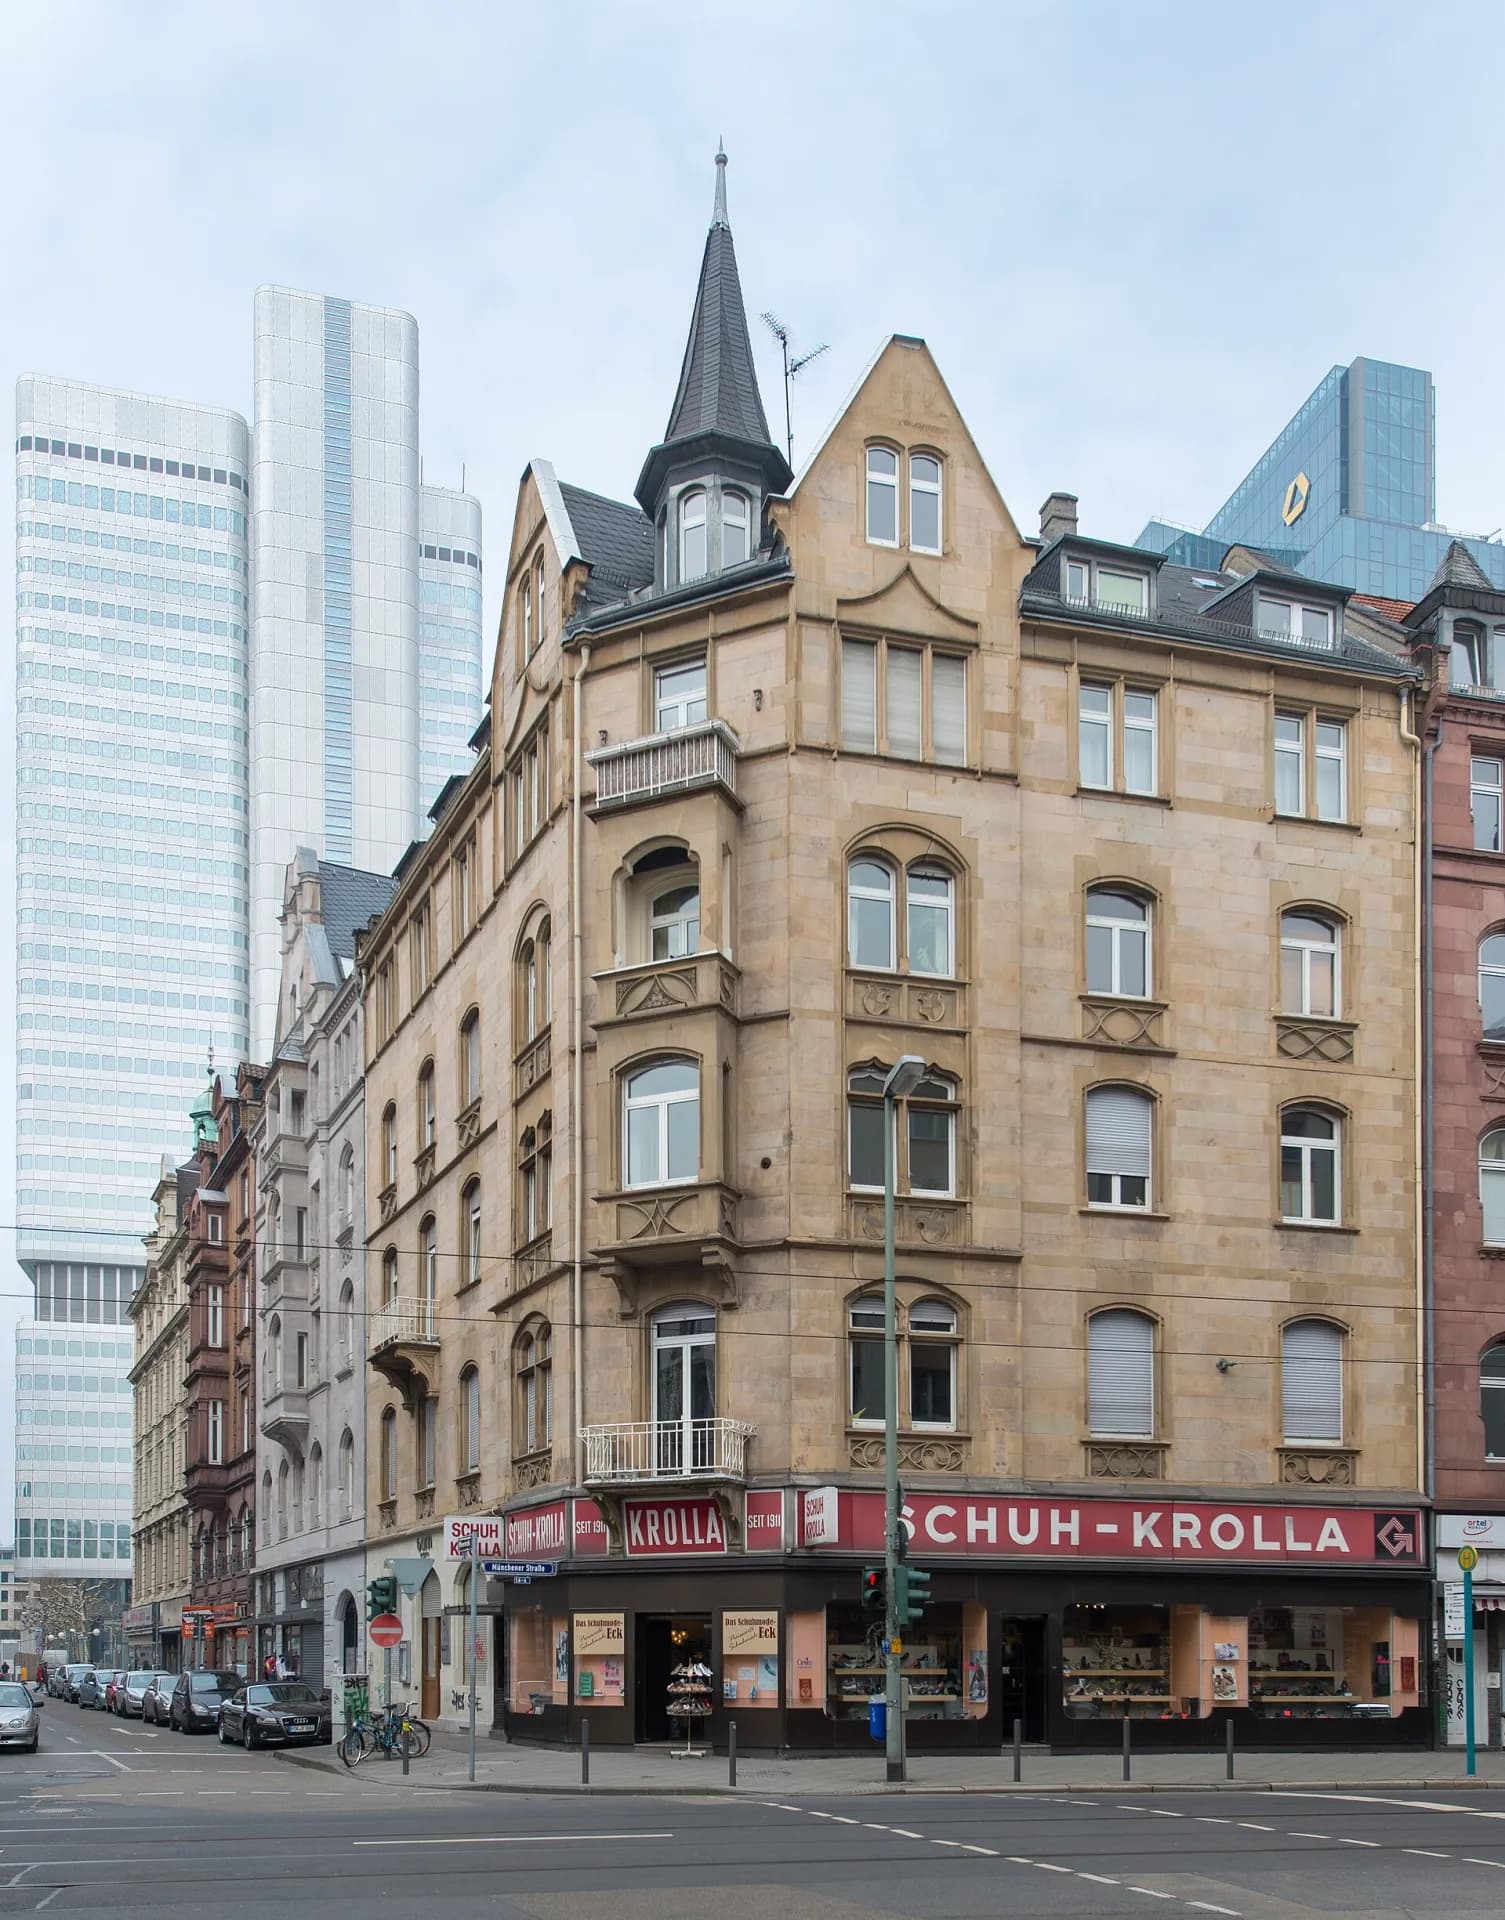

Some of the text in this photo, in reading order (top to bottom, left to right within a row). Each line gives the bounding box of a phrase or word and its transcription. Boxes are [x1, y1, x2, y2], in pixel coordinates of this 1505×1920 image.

[806, 1495, 824, 1517] SCHUH
[576, 1520, 592, 1534] SEIT
[629, 1507, 722, 1547] KROLLA
[748, 1513, 781, 1529] SEIT 1911
[806, 1518, 825, 1539] KROLLA
[451, 1522, 499, 1538] SCHUH
[508, 1511, 565, 1556] SCHUH-KROLLA
[491, 1563, 546, 1573] Münchener Straße
[606, 1628, 623, 1640] Eck
[758, 1626, 777, 1639] Eck
